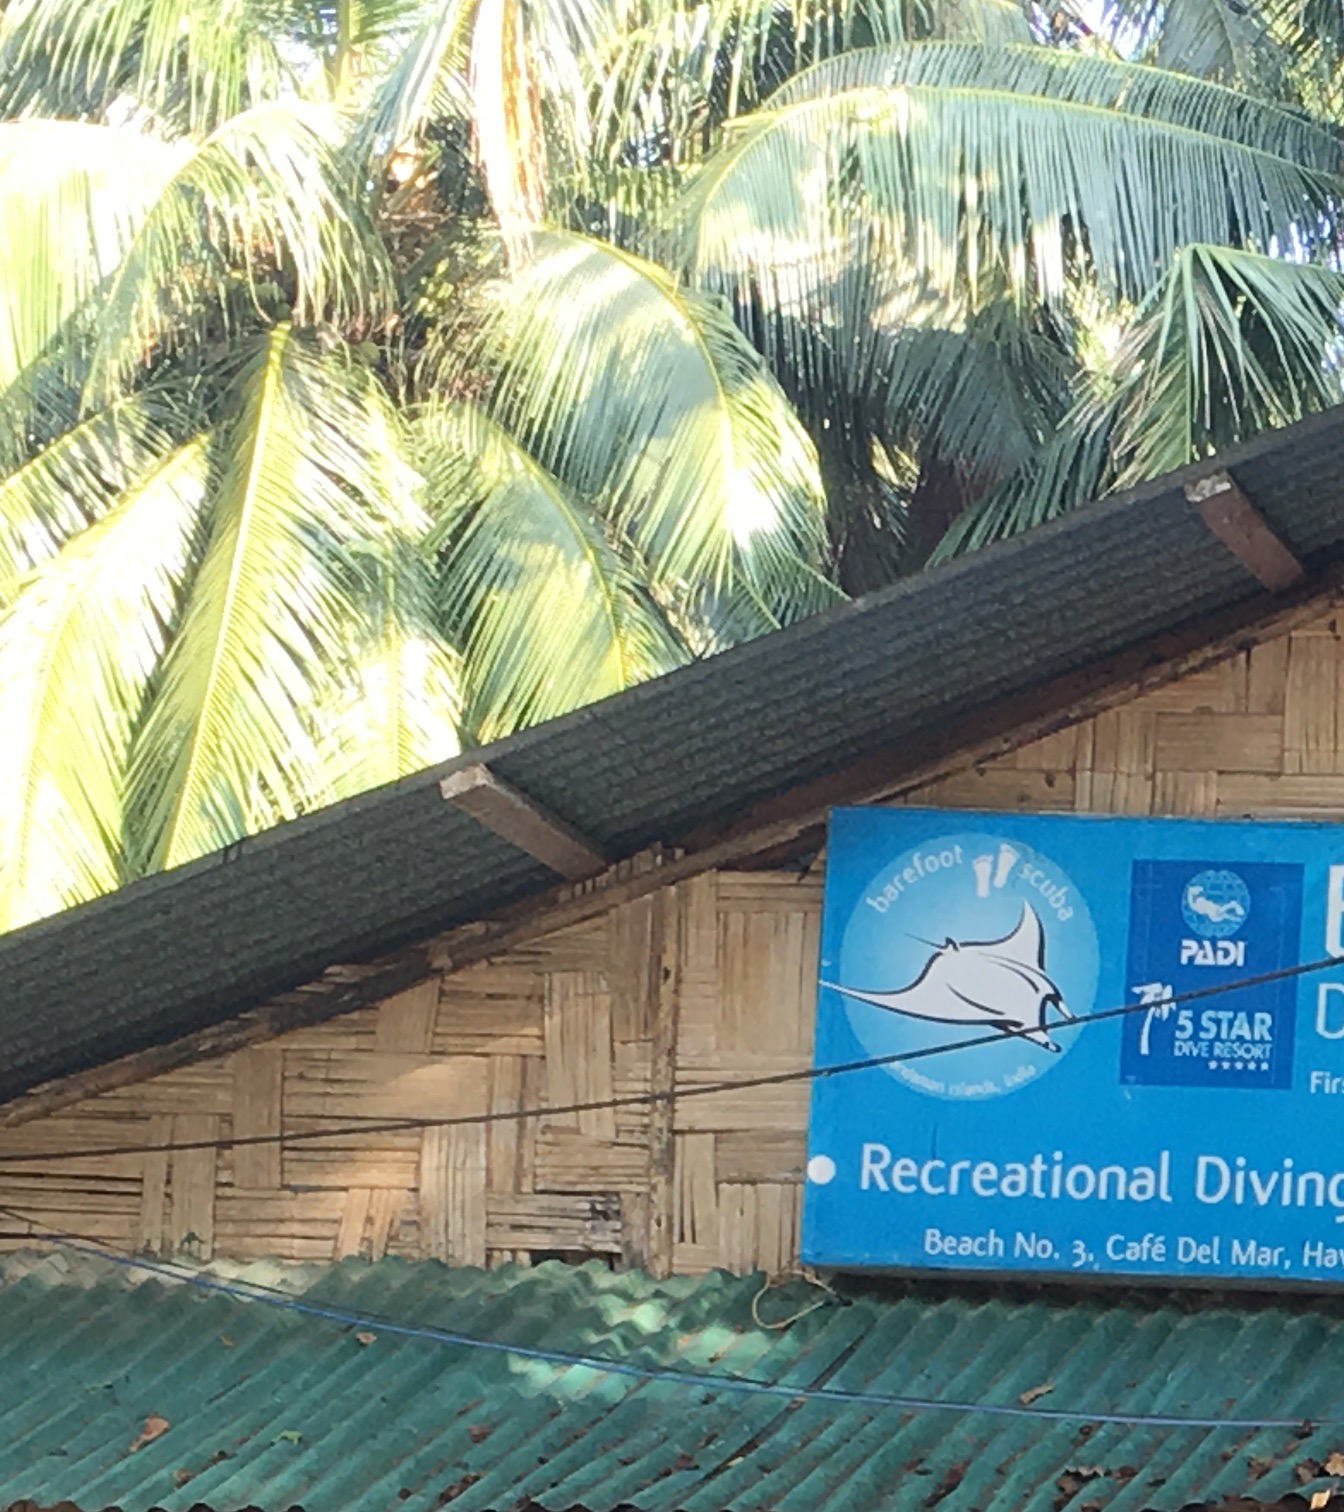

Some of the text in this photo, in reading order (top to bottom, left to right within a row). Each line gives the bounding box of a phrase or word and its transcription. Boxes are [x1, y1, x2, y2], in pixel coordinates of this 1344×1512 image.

[867, 845, 1075, 922] barefoot scuba
[1180, 939, 1246, 967] PADI
[1174, 1009, 1273, 1041] 5 STAR
[1173, 1040, 1273, 1060] DIVE RESORT
[861, 1143, 1173, 1203] Recreational
[924, 1228, 1004, 1258] Beach
[1014, 1231, 1060, 1260] No.
[1106, 1232, 1167, 1263] Café
[1177, 1235, 1220, 1265] Del
[1230, 1237, 1291, 1271] Mar,
